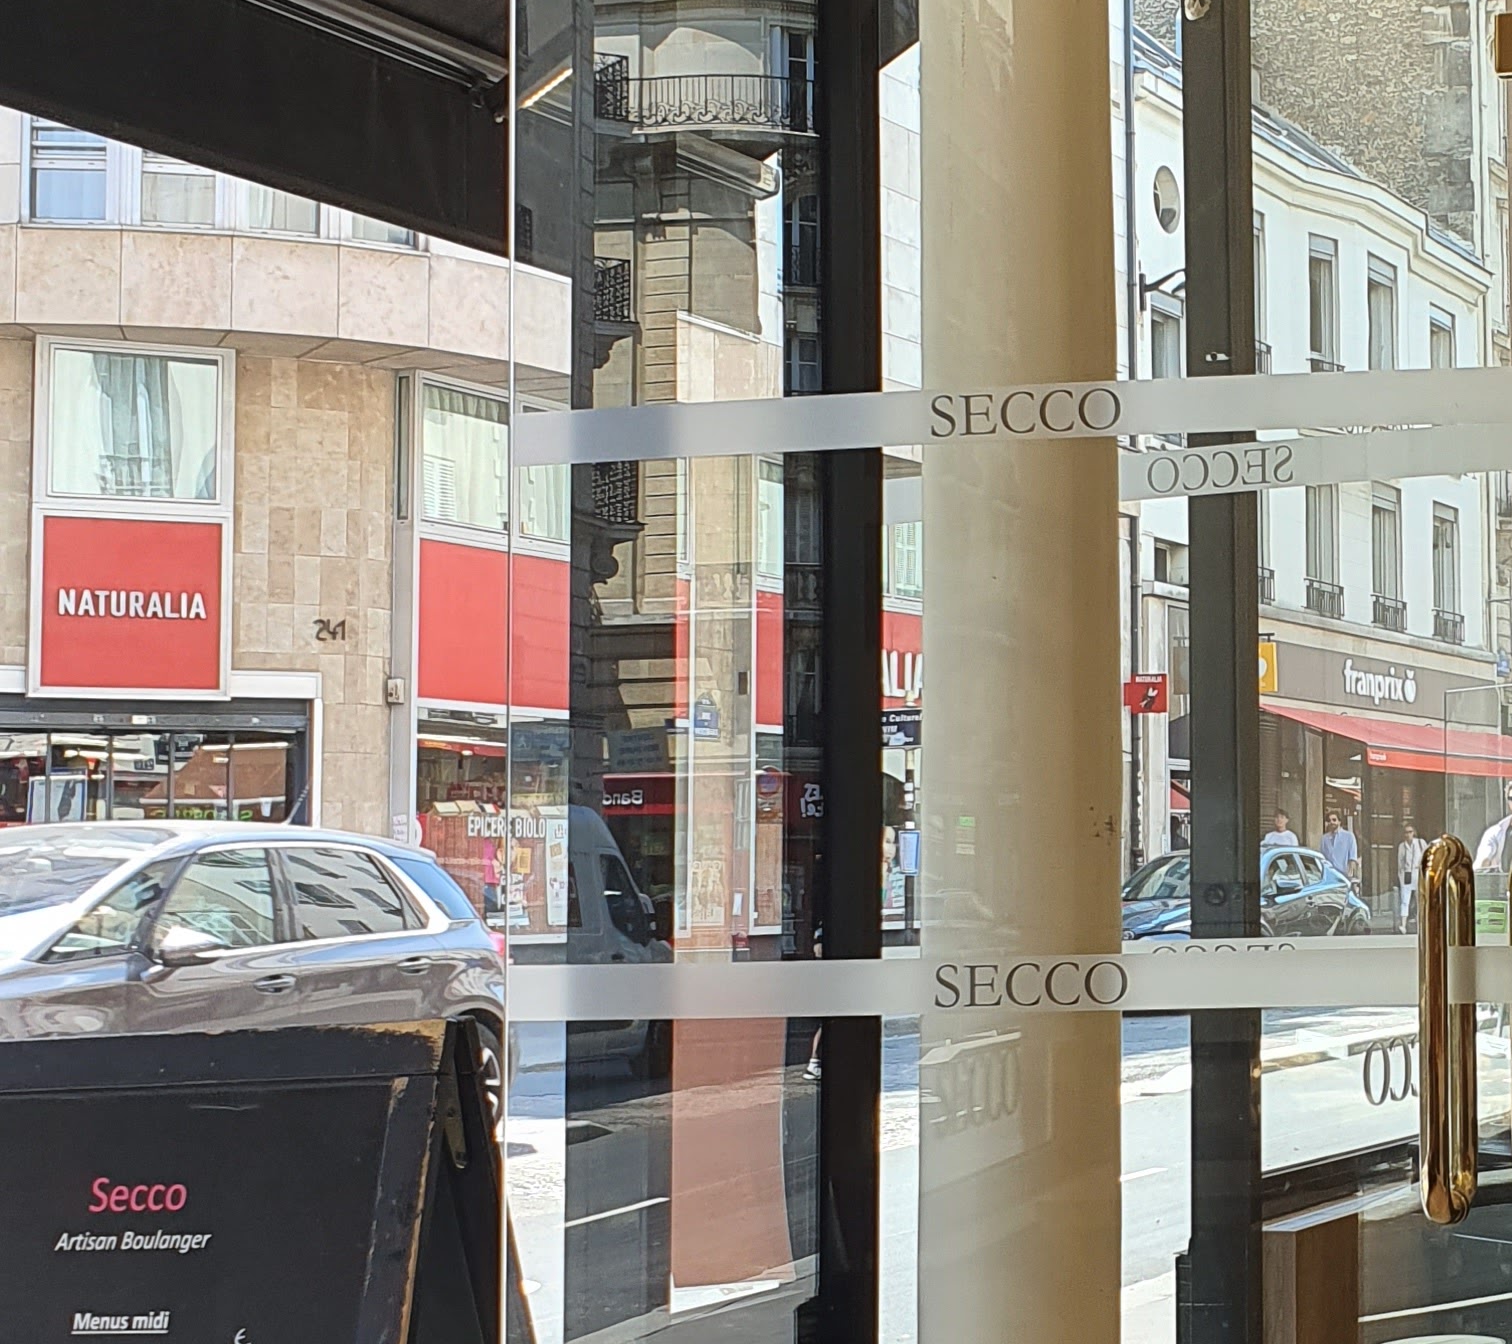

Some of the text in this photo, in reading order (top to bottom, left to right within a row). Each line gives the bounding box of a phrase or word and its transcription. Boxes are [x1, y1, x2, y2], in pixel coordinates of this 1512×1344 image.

[930, 388, 1121, 437] SECCO
[57, 588, 207, 619] NATURALIA
[312, 619, 346, 641] 241
[1343, 659, 1402, 705] franprix
[935, 961, 1128, 1008] SECCO
[89, 1177, 187, 1212] Secco
[54, 1229, 212, 1253] Artisan Boulanger
[72, 1311, 170, 1333] Menus midi
